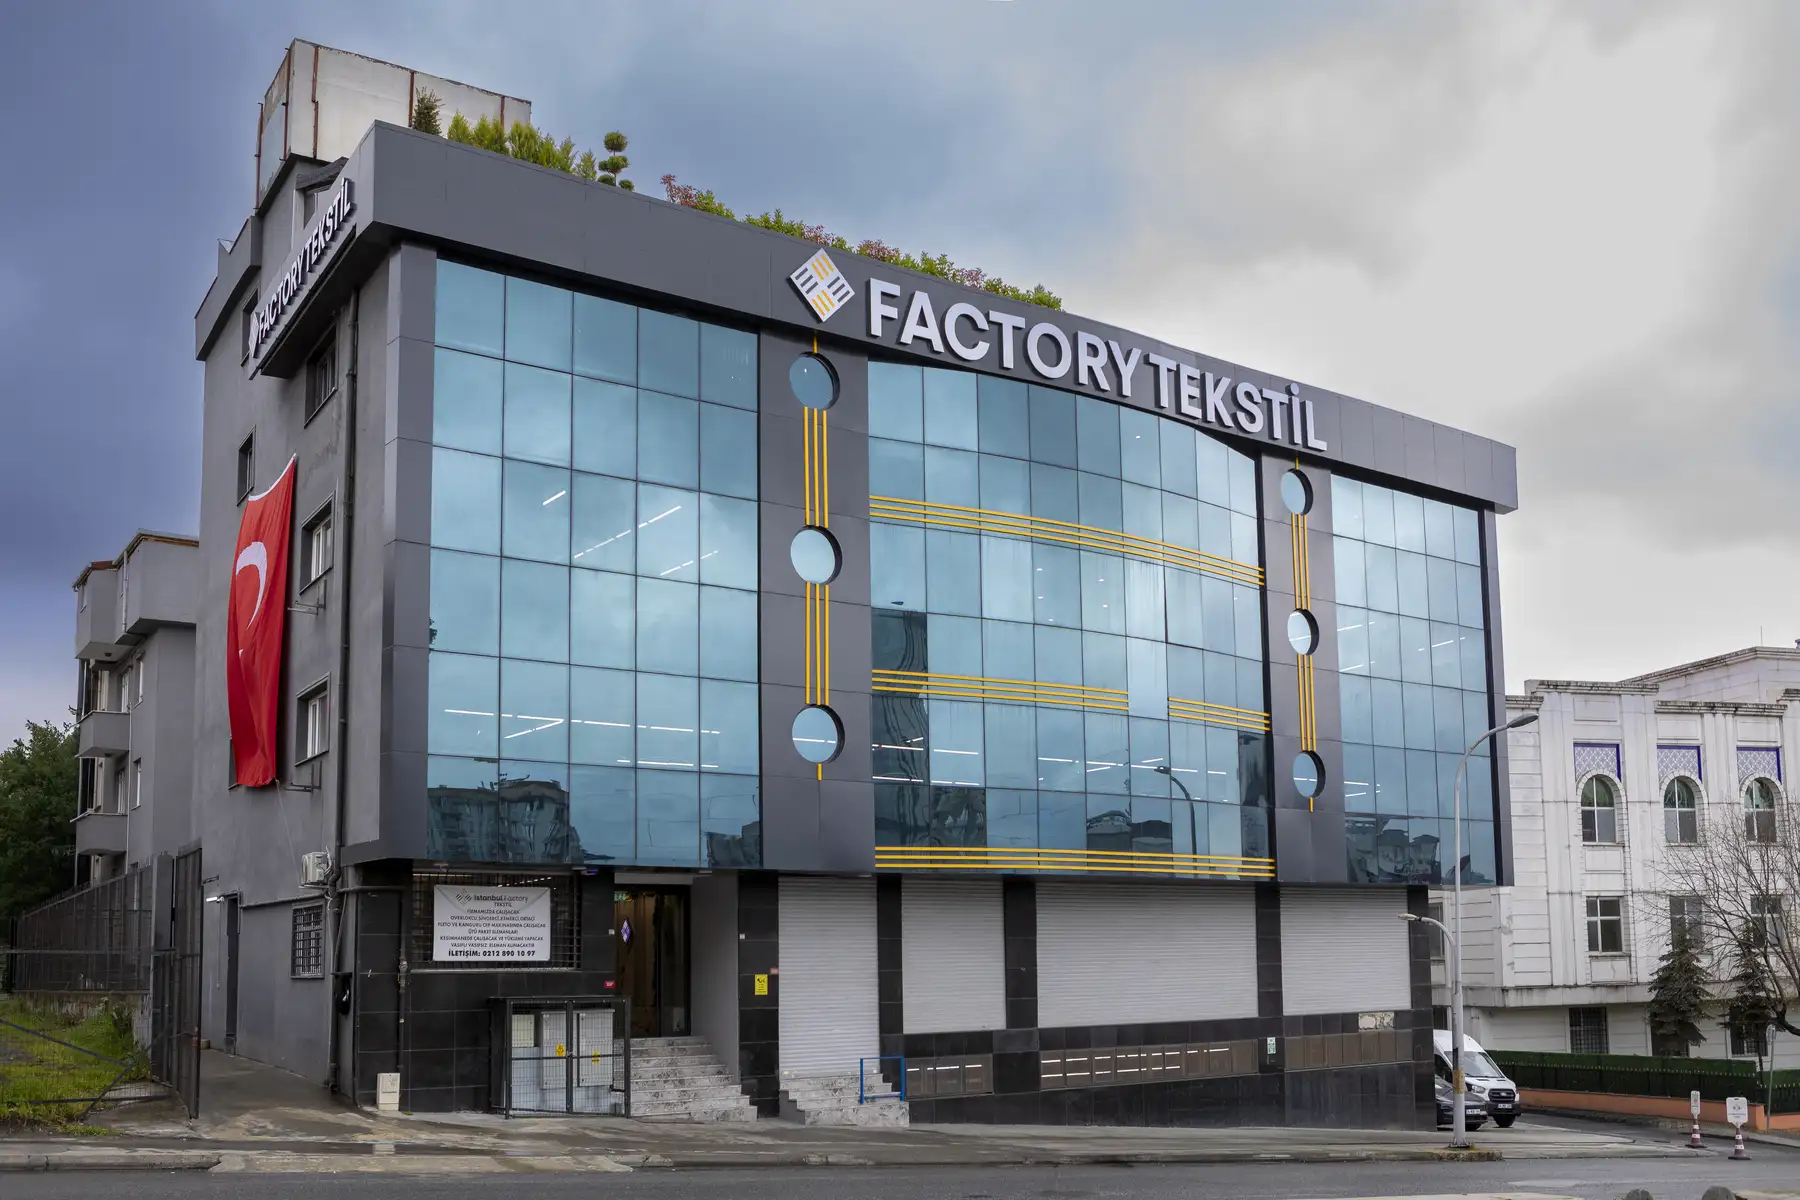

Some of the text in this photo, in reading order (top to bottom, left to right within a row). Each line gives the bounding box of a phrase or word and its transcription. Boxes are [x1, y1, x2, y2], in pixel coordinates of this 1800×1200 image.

[258, 177, 351, 344] FACTORY TEKSTİL
[868, 277, 1328, 452] FACTORY TEKSTİL
[448, 949, 481, 958] İLETİŞİM:
